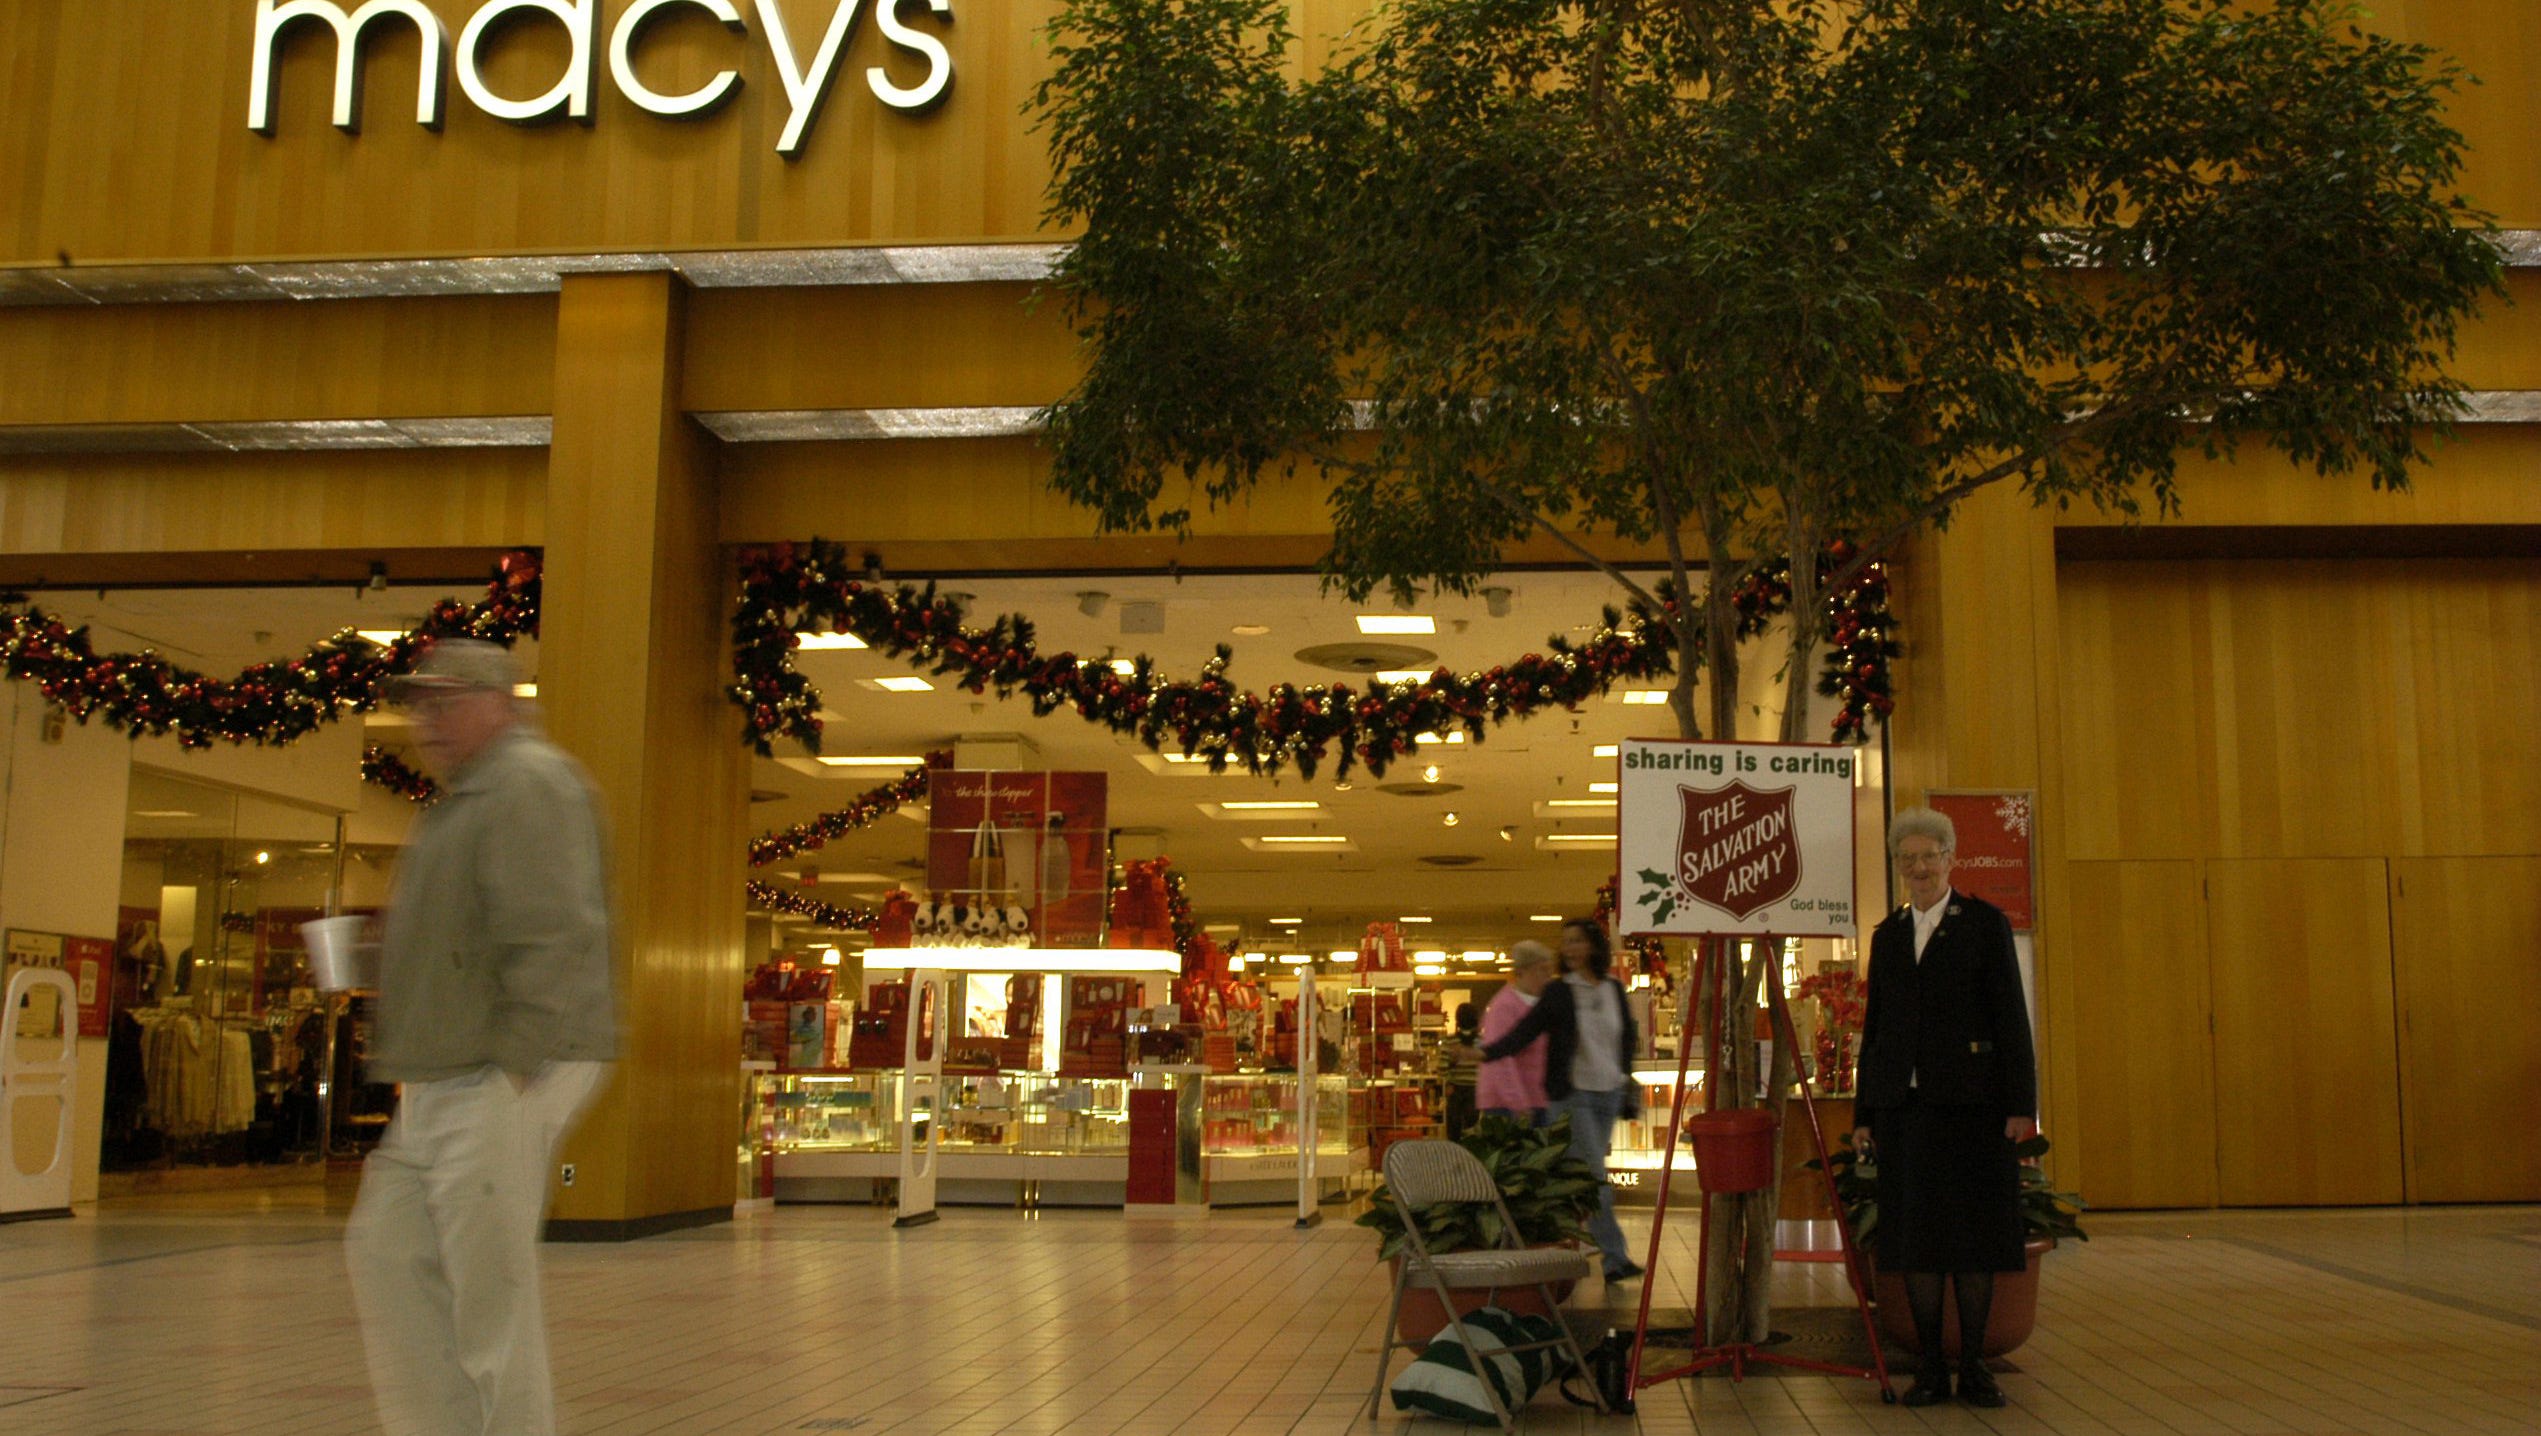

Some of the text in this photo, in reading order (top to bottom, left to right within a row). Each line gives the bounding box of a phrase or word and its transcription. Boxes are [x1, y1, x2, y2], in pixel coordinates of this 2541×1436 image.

[1625, 747, 1850, 778] sharing is caring
[1698, 794, 1746, 836] THE
[1682, 803, 1786, 883] SALVATION
[1724, 843, 1786, 902] ARMY
[1790, 899, 1849, 911] God bless
[1828, 913, 1849, 925] you
[1607, 1172, 1639, 1187] NIQUE
